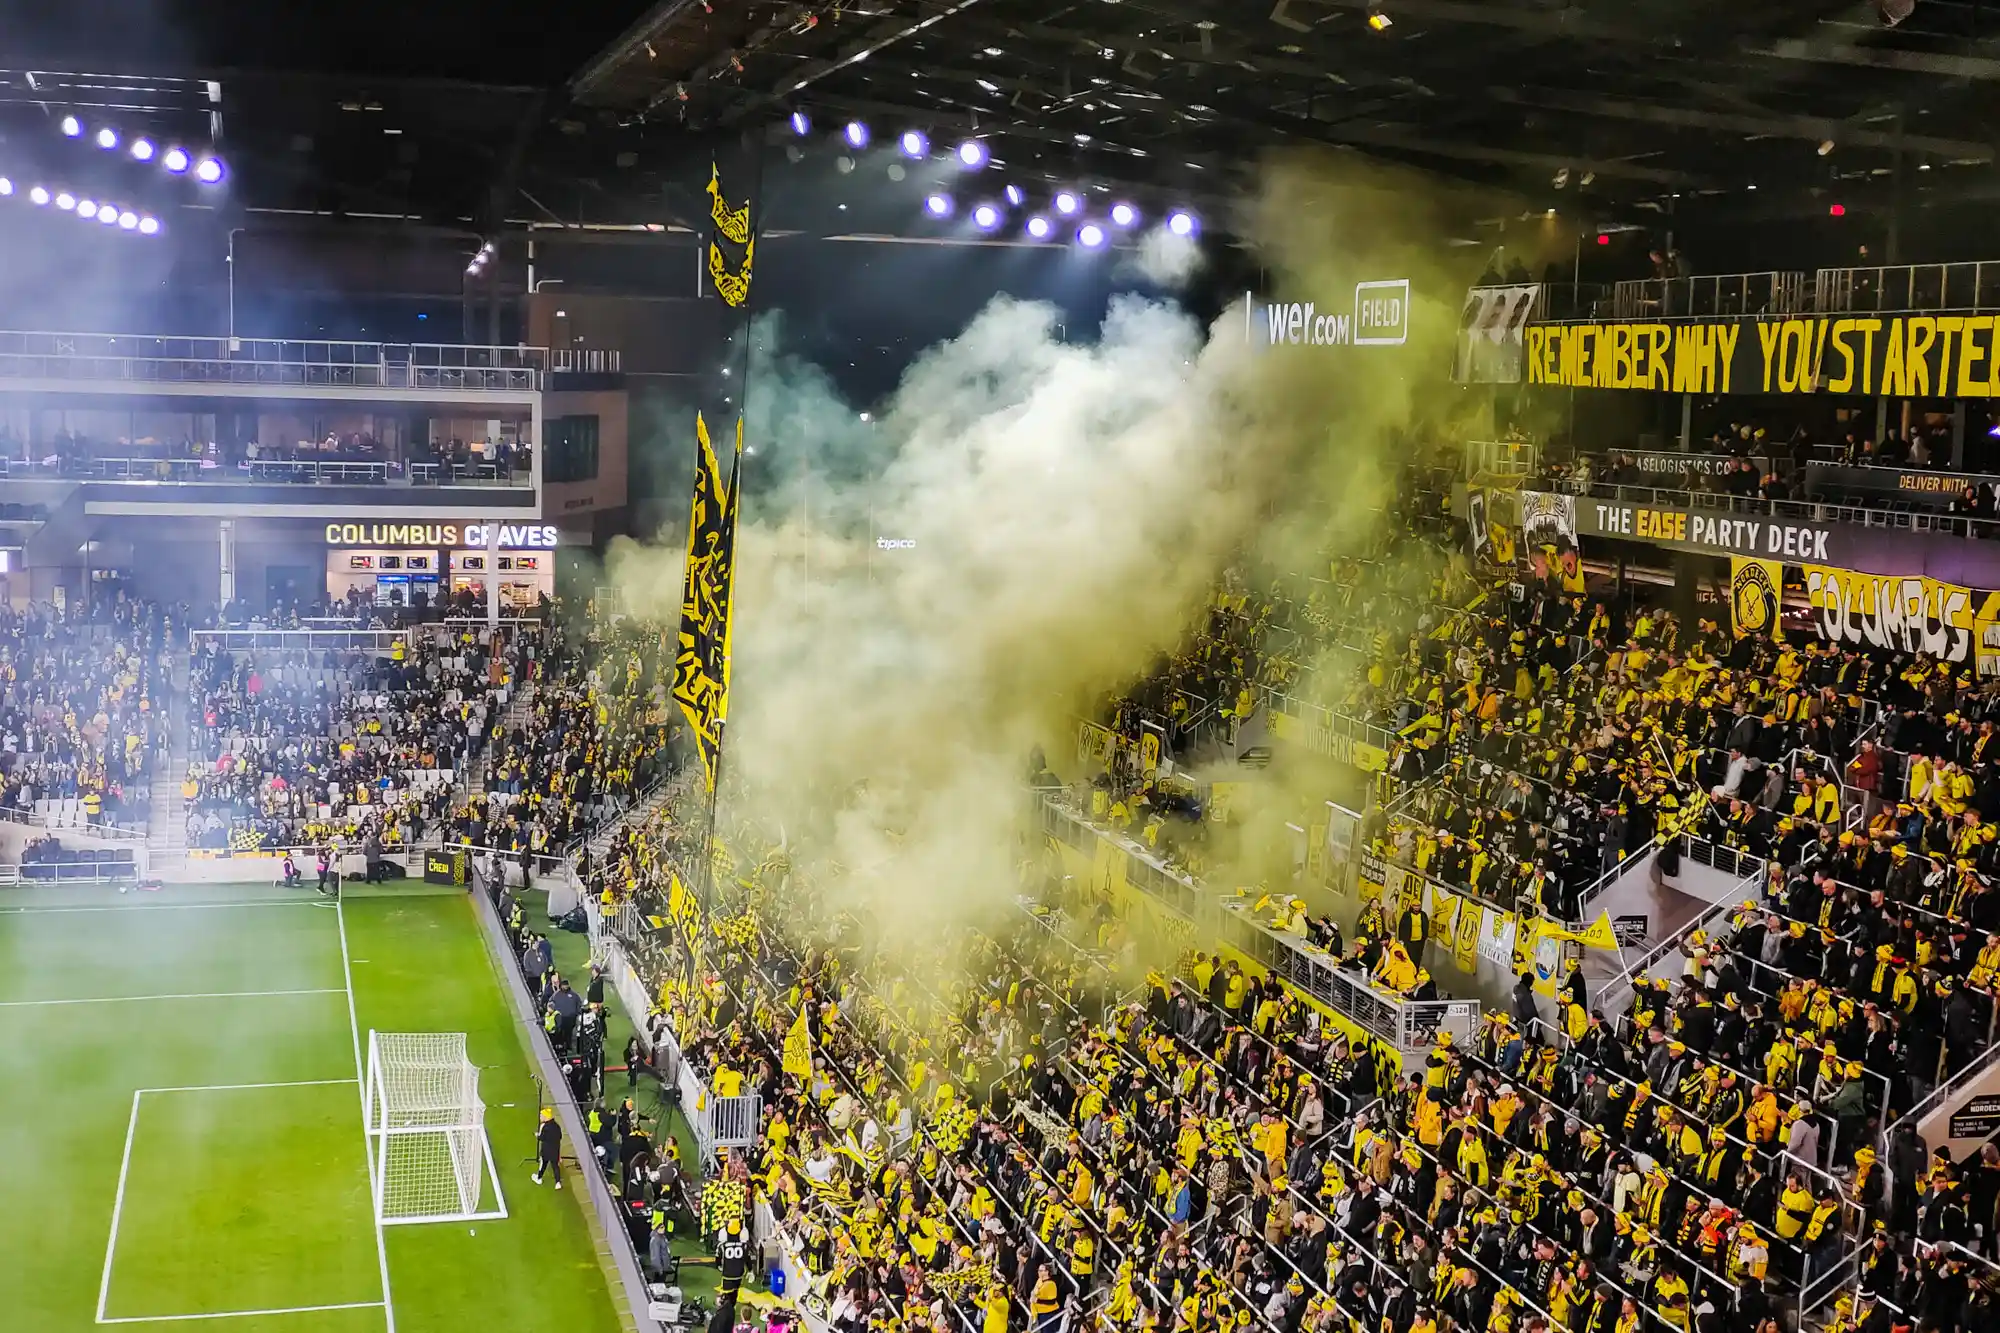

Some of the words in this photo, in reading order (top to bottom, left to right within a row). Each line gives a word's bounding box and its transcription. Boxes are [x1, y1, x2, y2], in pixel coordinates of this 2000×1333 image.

[1361, 298, 1400, 327] FIELD
[1673, 324, 1740, 394] WHY
[1757, 319, 1829, 393] YOU
[1899, 475, 1940, 490] DELIVER
[1943, 478, 1969, 492] WITH
[325, 524, 457, 545] COLUMBUS
[1596, 505, 1632, 534] THE
[1637, 509, 1687, 540] EASE
[1692, 515, 1761, 550] PARTY
[1768, 524, 1830, 561] DECK
[877, 537, 916, 550] tipico
[428, 862, 449, 873] CREW
[725, 1246, 743, 1259] 00
